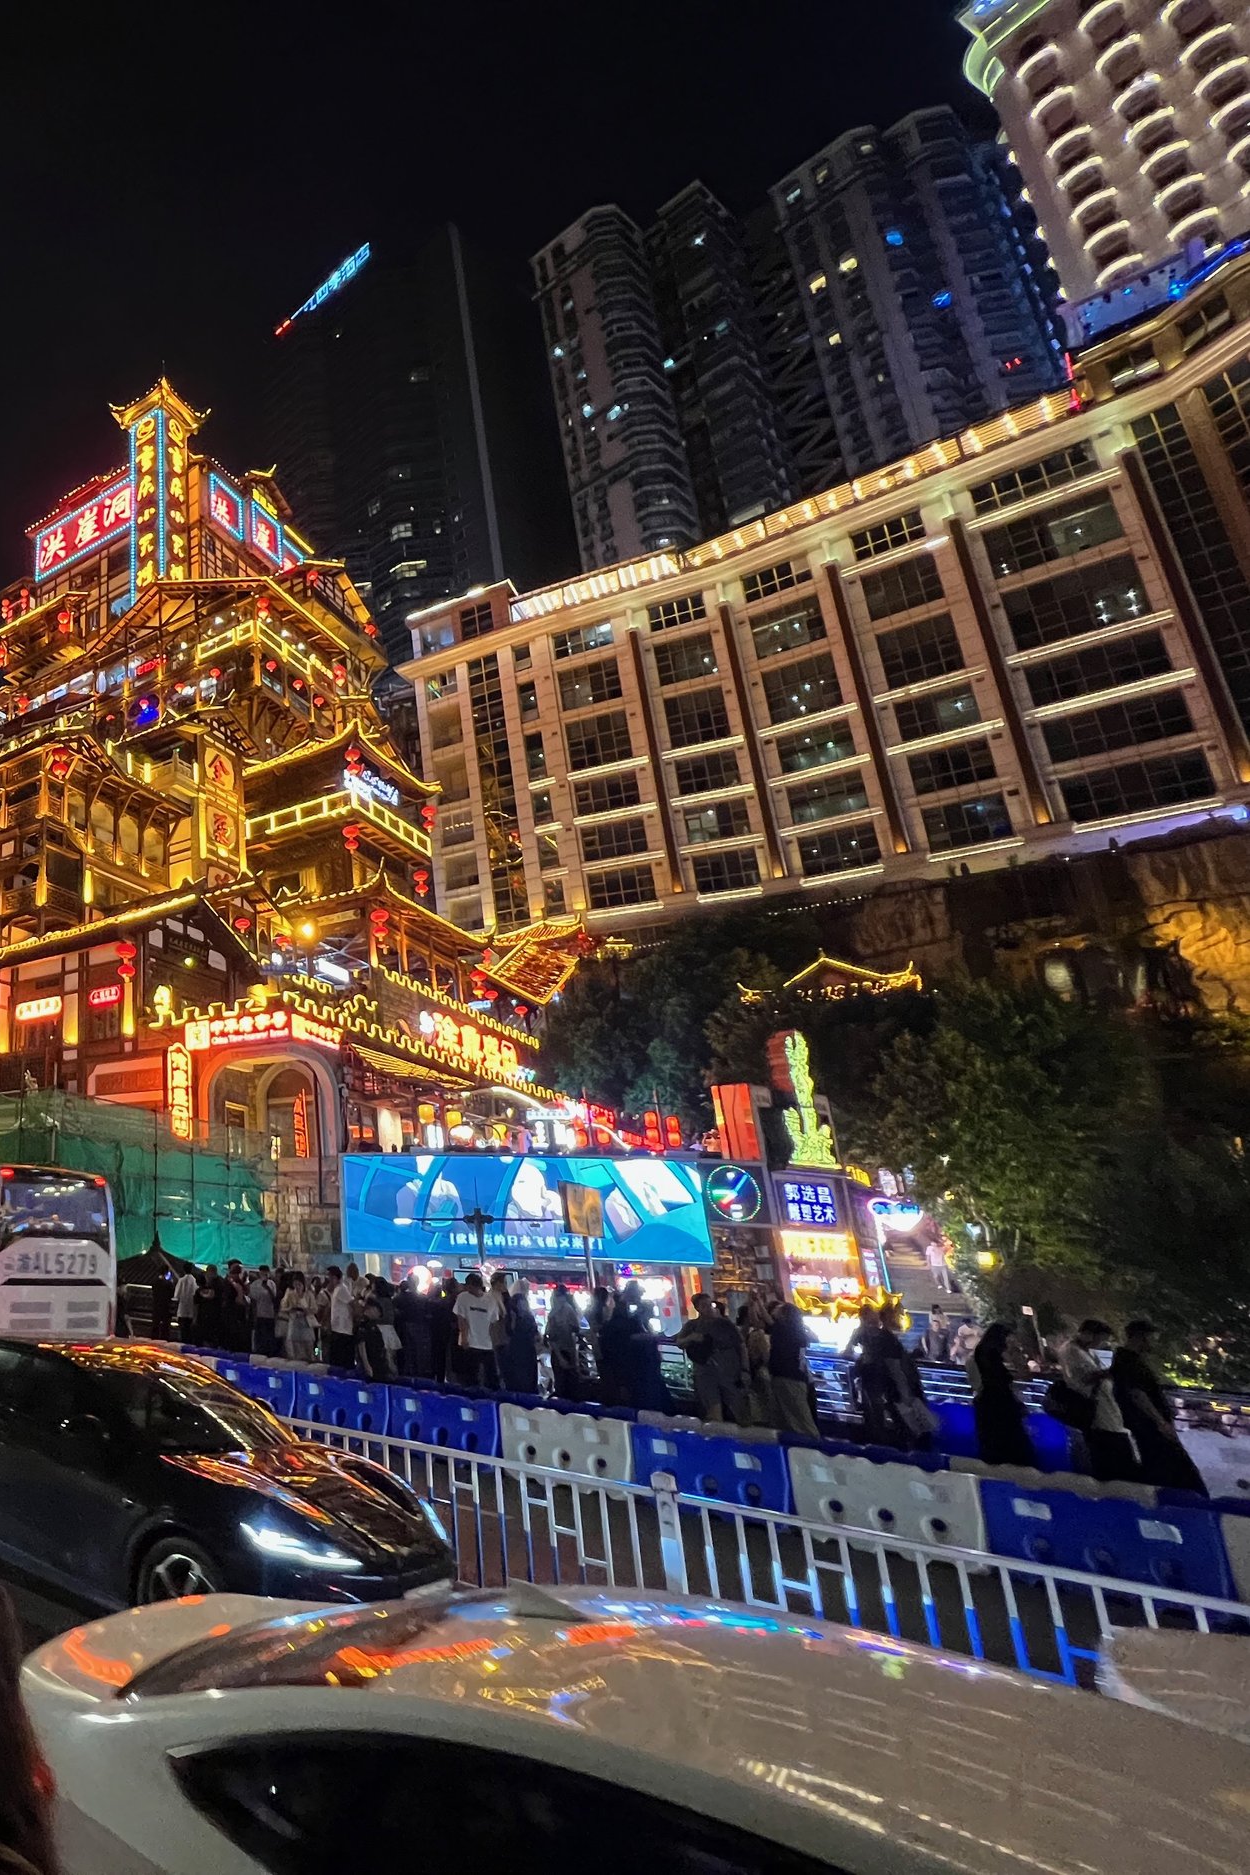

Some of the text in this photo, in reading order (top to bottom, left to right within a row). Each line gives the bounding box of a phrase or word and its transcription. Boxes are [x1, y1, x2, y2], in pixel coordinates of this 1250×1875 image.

[40, 487, 132, 569] 洪崖洞
[784, 1183, 833, 1204] 郭选昌
[787, 1202, 837, 1224] 雕塑艺术
